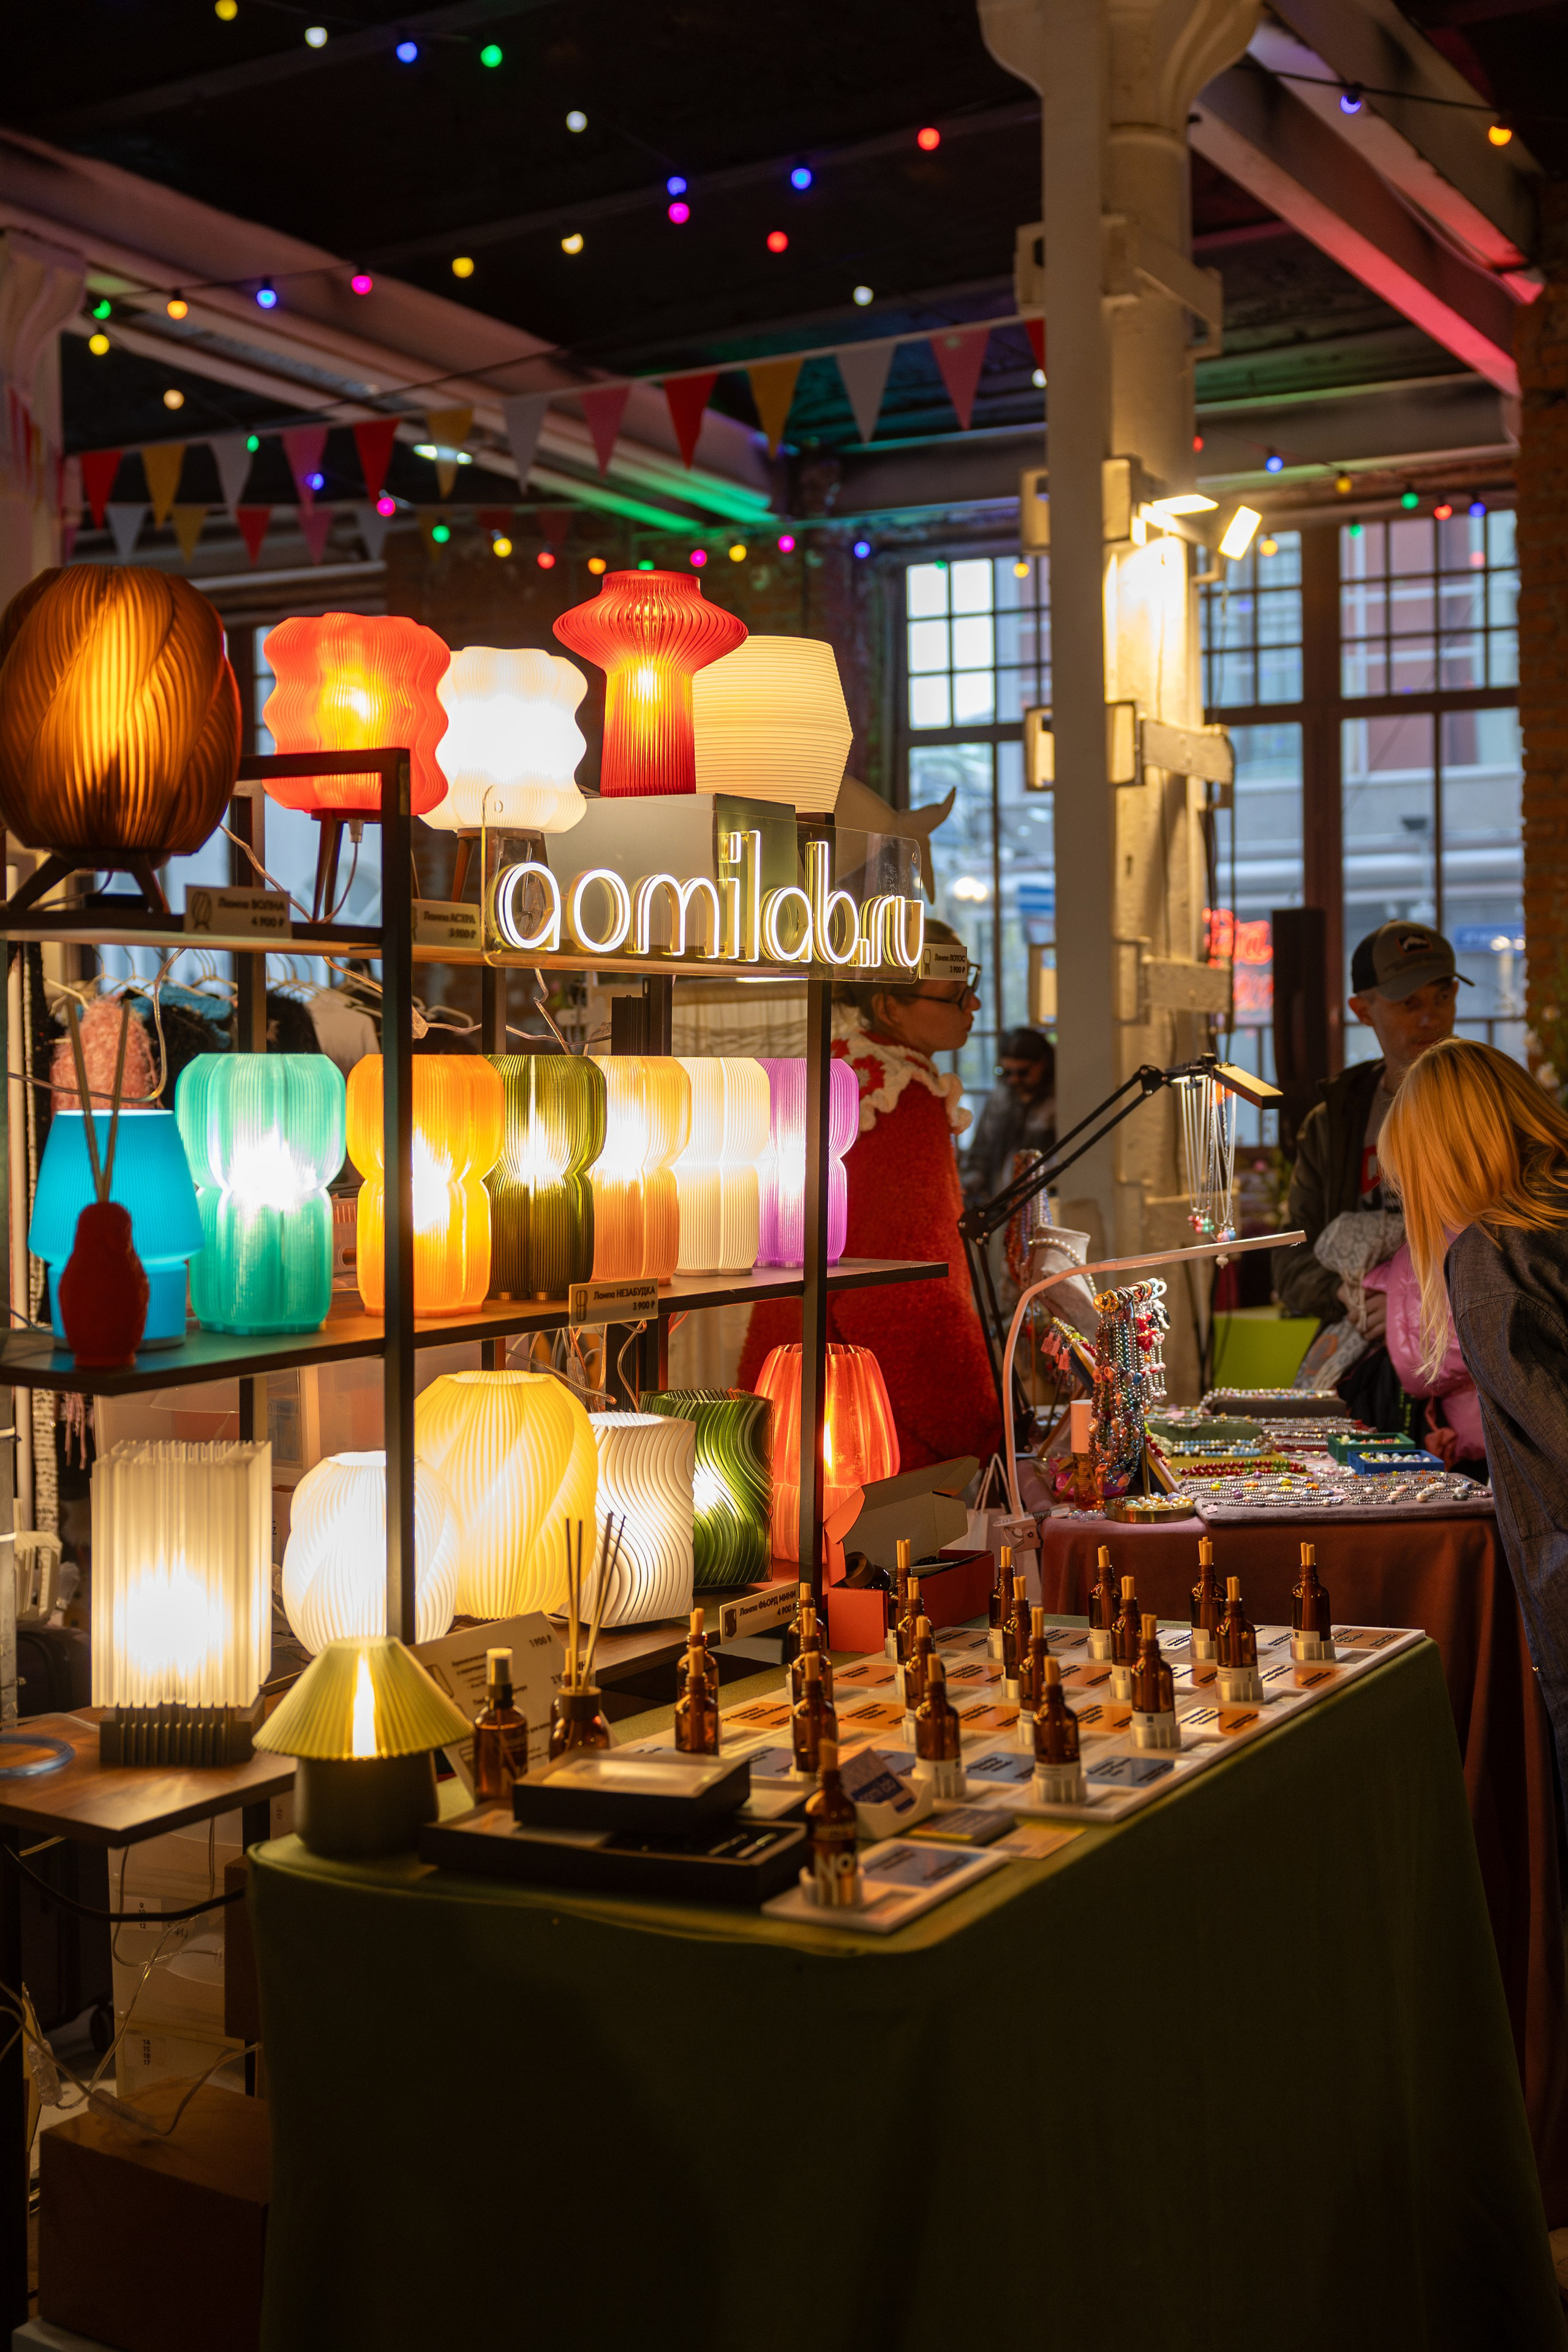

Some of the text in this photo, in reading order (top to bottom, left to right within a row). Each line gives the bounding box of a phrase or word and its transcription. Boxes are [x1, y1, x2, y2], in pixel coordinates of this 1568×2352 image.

[949, 954, 966, 963] ЛОТОС
[594, 1286, 655, 1300] Лампа НЕЗАБУДКА
[739, 1590, 796, 1616] Лампа ФЬОРД МИНИ
